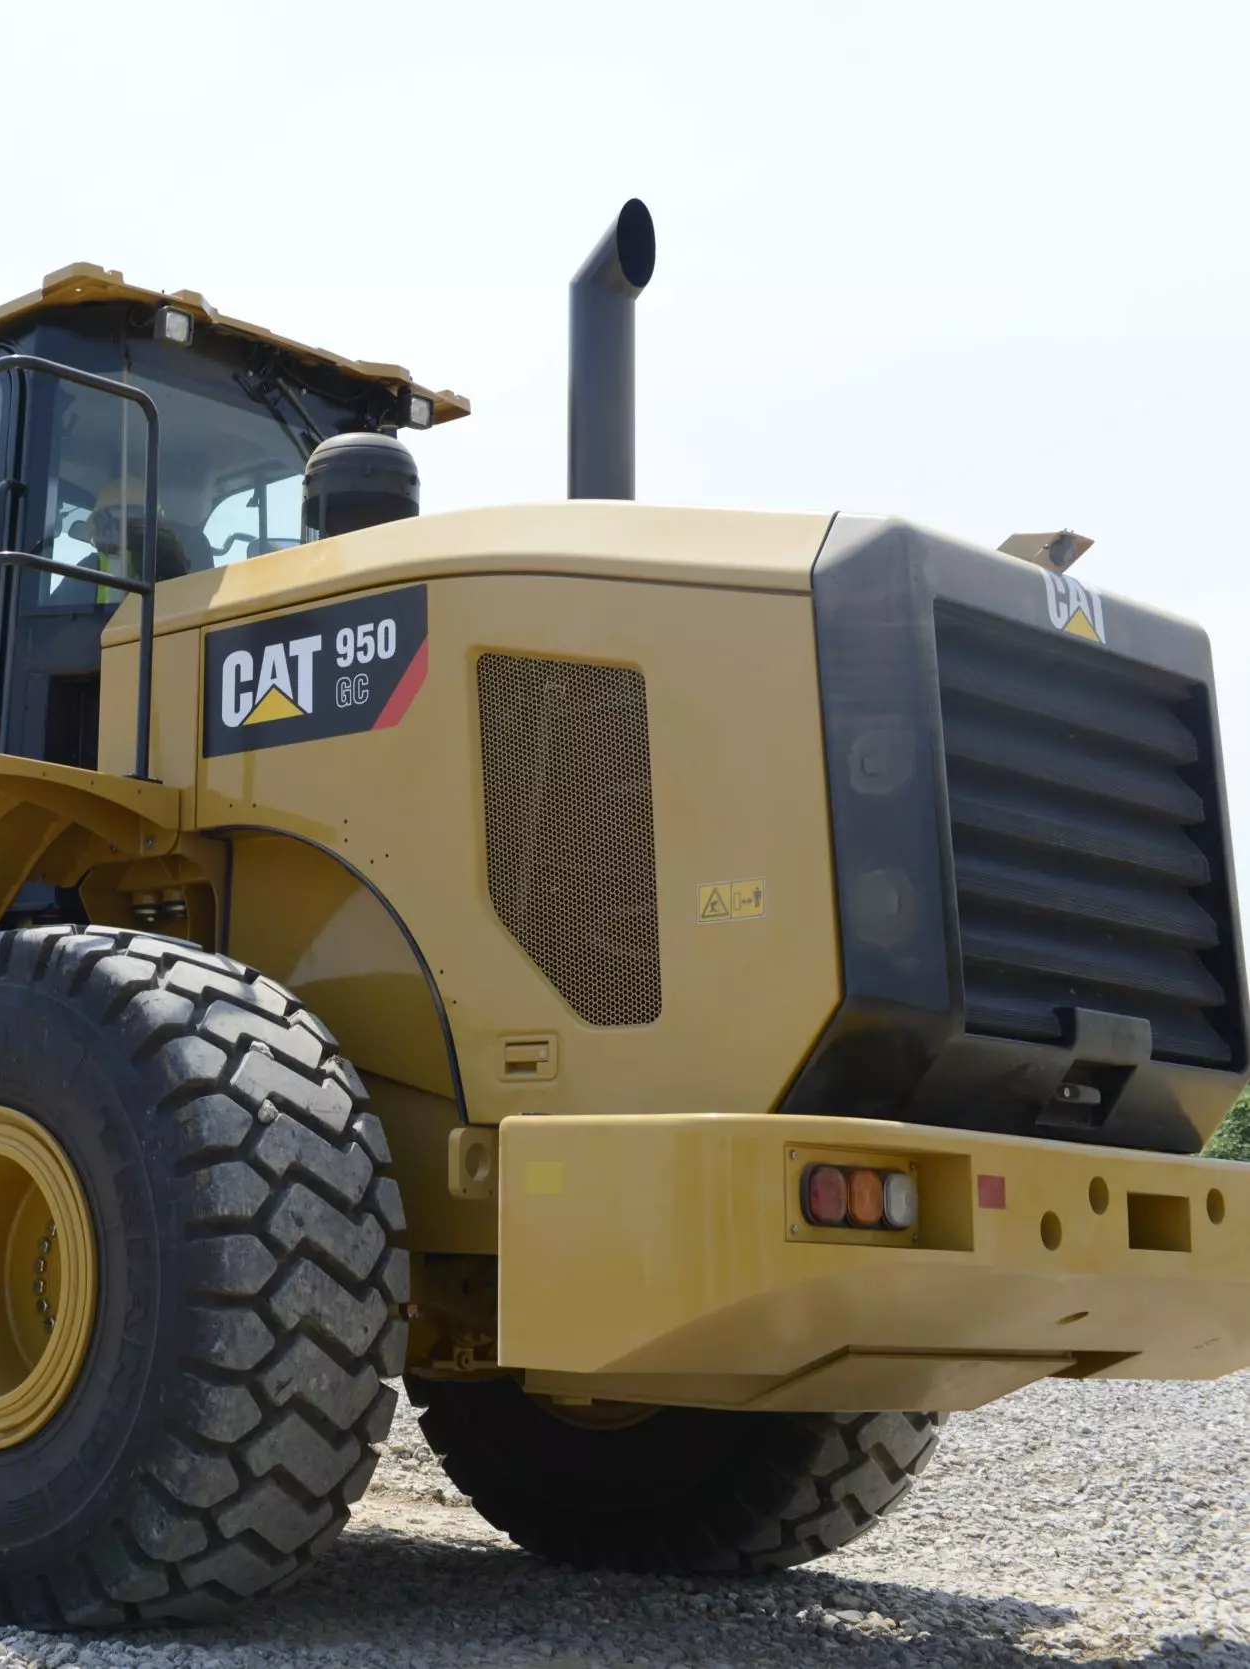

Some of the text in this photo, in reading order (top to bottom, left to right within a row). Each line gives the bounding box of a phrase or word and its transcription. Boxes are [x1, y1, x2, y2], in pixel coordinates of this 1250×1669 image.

[1040, 567, 1106, 645] CAT
[335, 618, 396, 668] 950
[221, 634, 322, 728] CAT
[335, 673, 369, 708] GC
